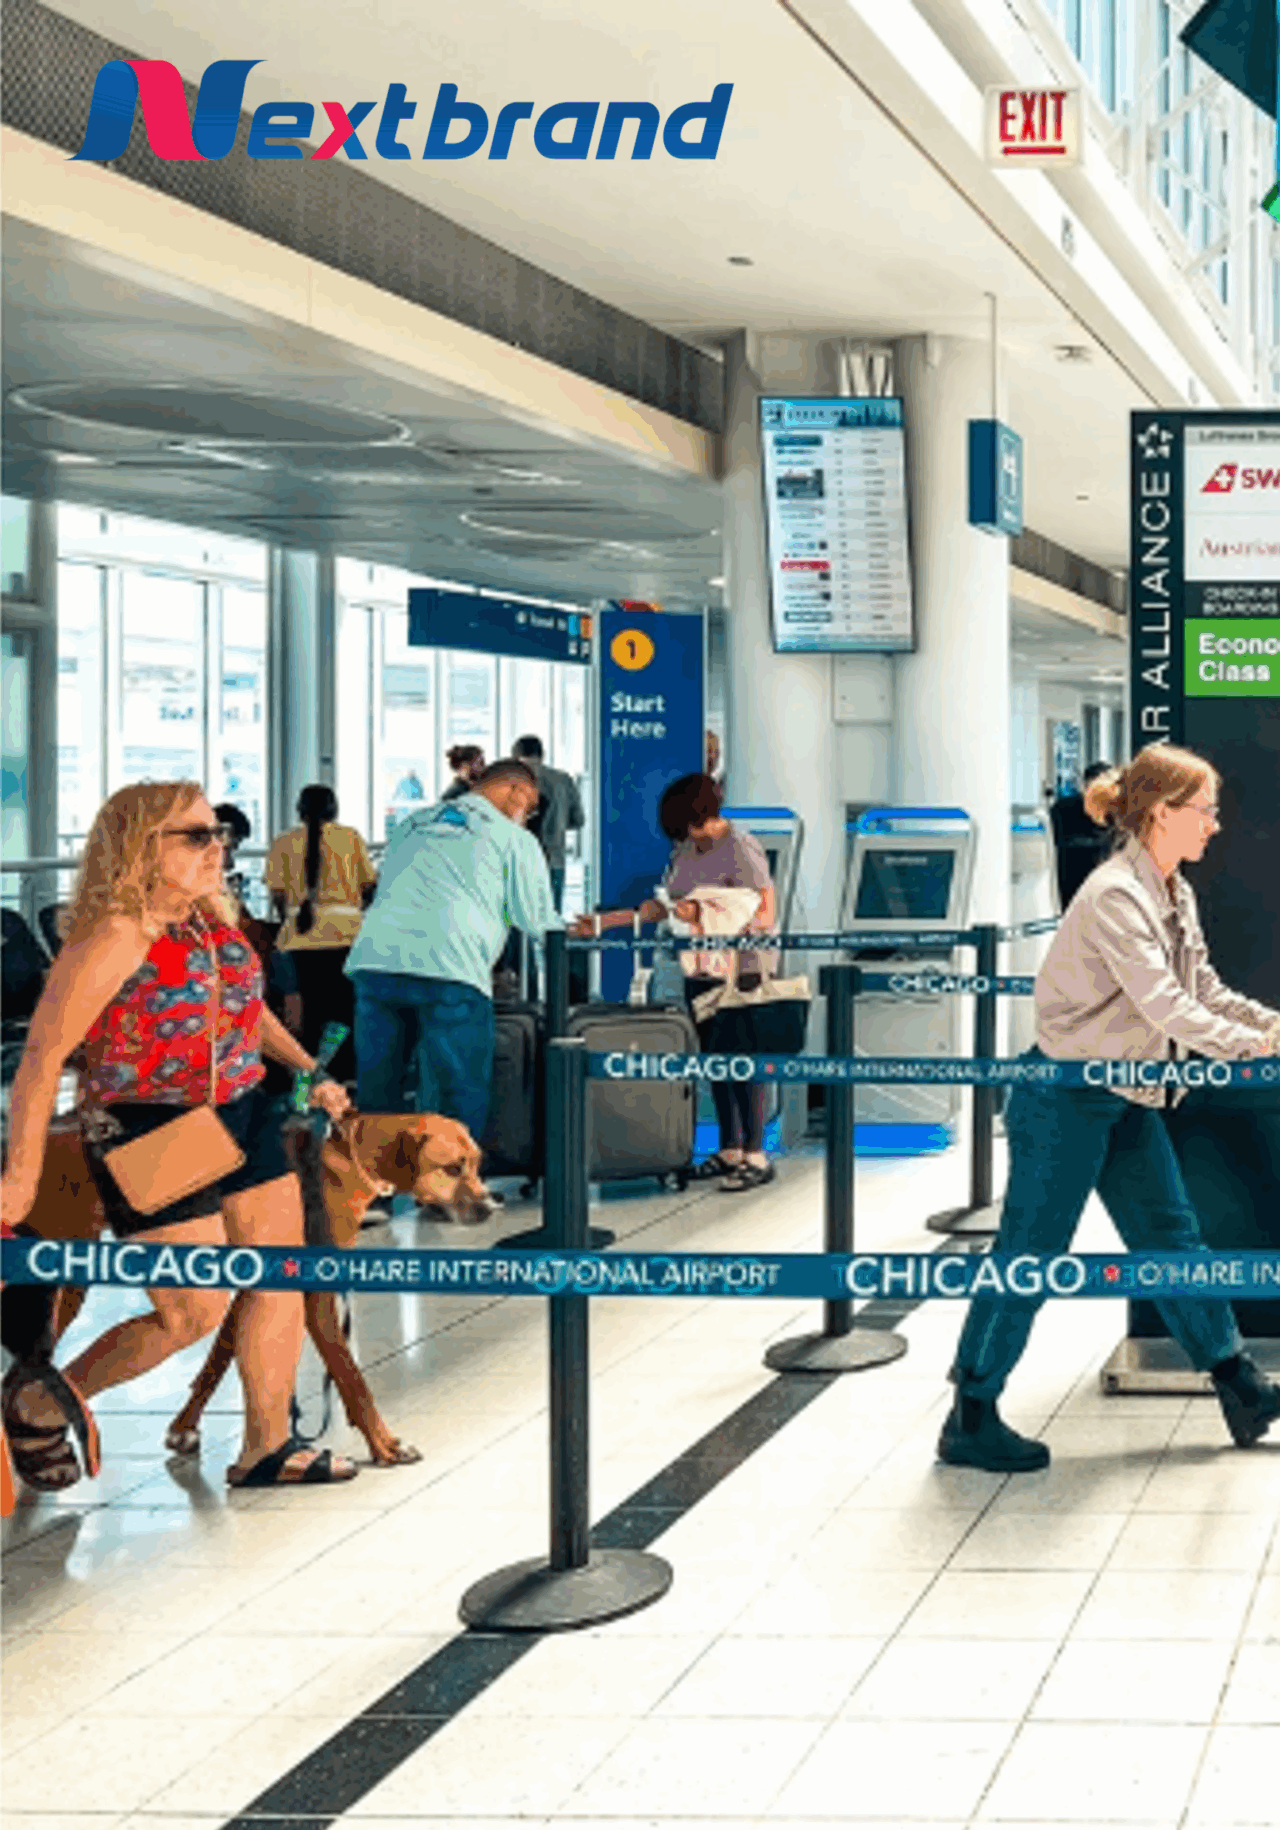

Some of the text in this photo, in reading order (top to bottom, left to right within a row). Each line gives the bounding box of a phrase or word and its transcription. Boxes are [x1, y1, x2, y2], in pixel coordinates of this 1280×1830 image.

[1000, 91, 1067, 142] EXIT
[1141, 472, 1170, 690] ALLIANCE
[624, 638, 637, 661] 1
[1199, 660, 1271, 682] Class
[610, 692, 666, 713] Start
[610, 718, 667, 739] Here
[888, 975, 990, 994] CHICAGO
[603, 1051, 756, 1082] CHICAGO
[1082, 1059, 1232, 1087] CHICAGO
[26, 1239, 264, 1286] CHICAGO
[313, 1256, 421, 1282] O'HARE
[429, 1258, 656, 1287] INTERNATIONAL
[661, 1261, 781, 1287] AIRPORT
[845, 1255, 1086, 1295] CHICAGO
[1137, 1260, 1245, 1287] O'HARE
